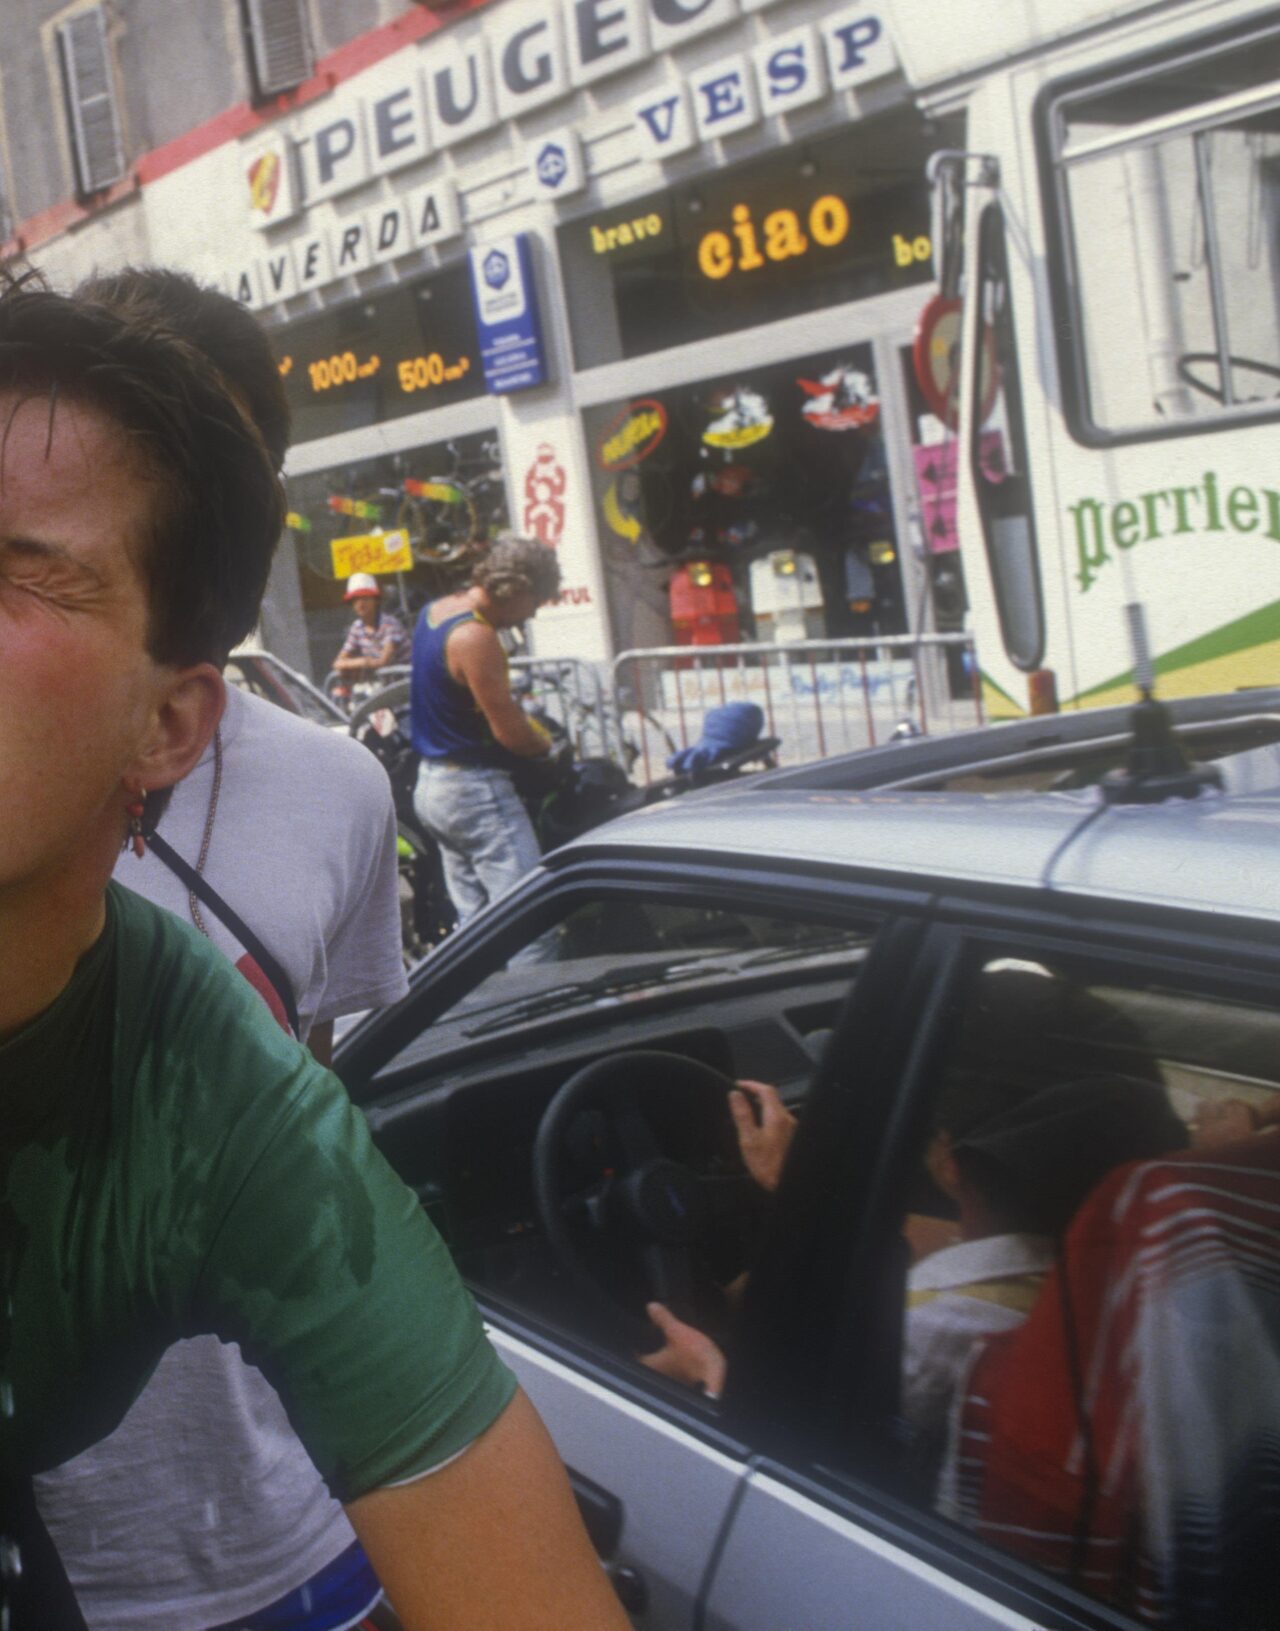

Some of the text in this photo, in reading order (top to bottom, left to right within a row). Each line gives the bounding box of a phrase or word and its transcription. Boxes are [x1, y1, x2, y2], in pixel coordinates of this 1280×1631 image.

[639, 16, 882, 144] VESP
[590, 194, 933, 280] bravo ciao bo
